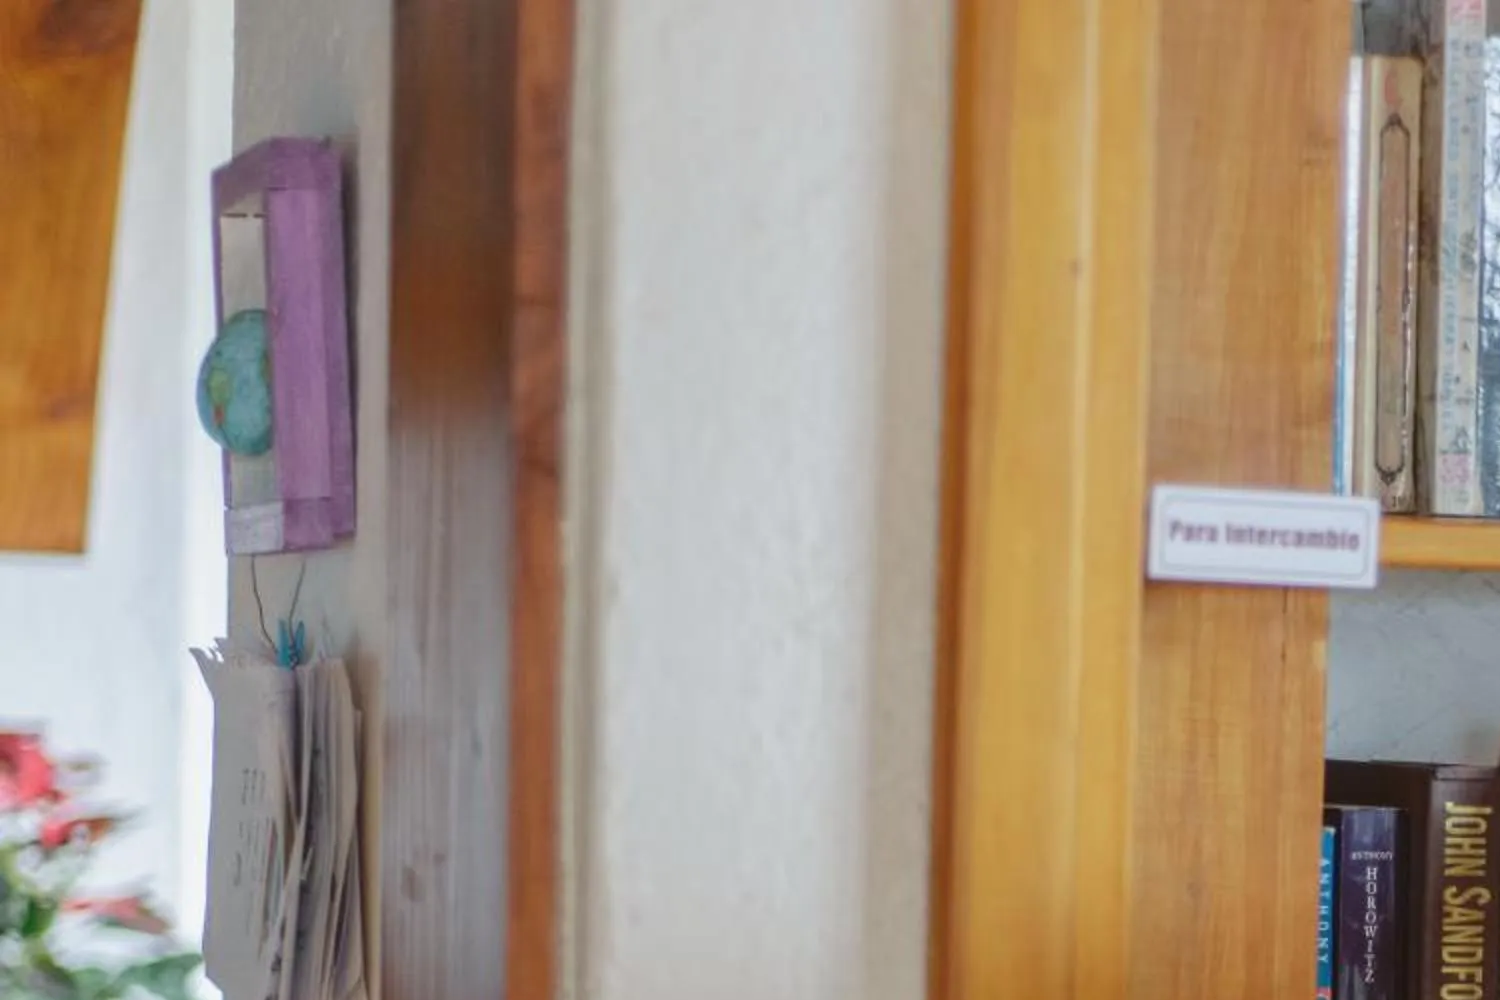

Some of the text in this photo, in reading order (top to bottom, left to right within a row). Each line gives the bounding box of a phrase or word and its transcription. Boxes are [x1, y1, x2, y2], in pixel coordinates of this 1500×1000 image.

[1170, 520, 1218, 543] Para
[1444, 801, 1493, 878] JOHN
[1364, 867, 1378, 983] HOROWITZ
